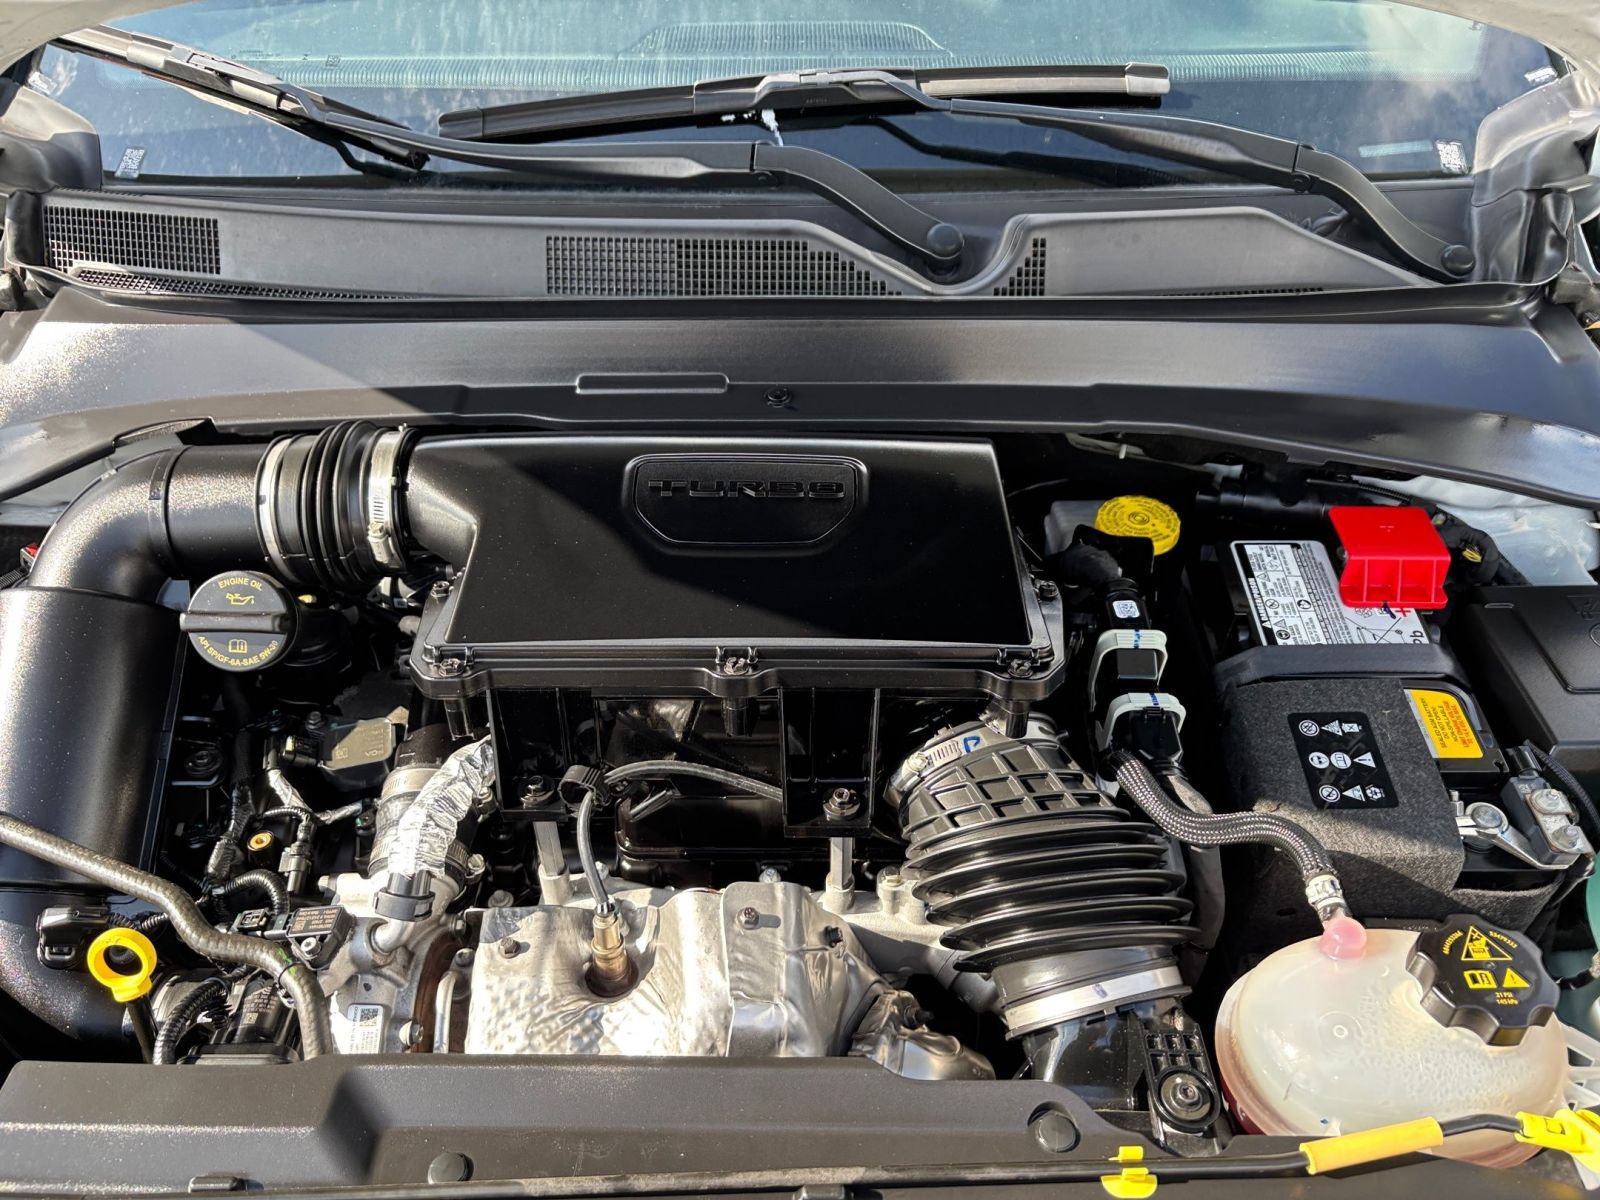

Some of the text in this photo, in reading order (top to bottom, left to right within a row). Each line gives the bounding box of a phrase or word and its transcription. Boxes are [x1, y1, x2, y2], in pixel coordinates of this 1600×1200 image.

[648, 479, 845, 498] TURBO
[218, 577, 263, 591] ENGINE OIL
[198, 636, 209, 649] API
[259, 640, 279, 660] 5W-30
